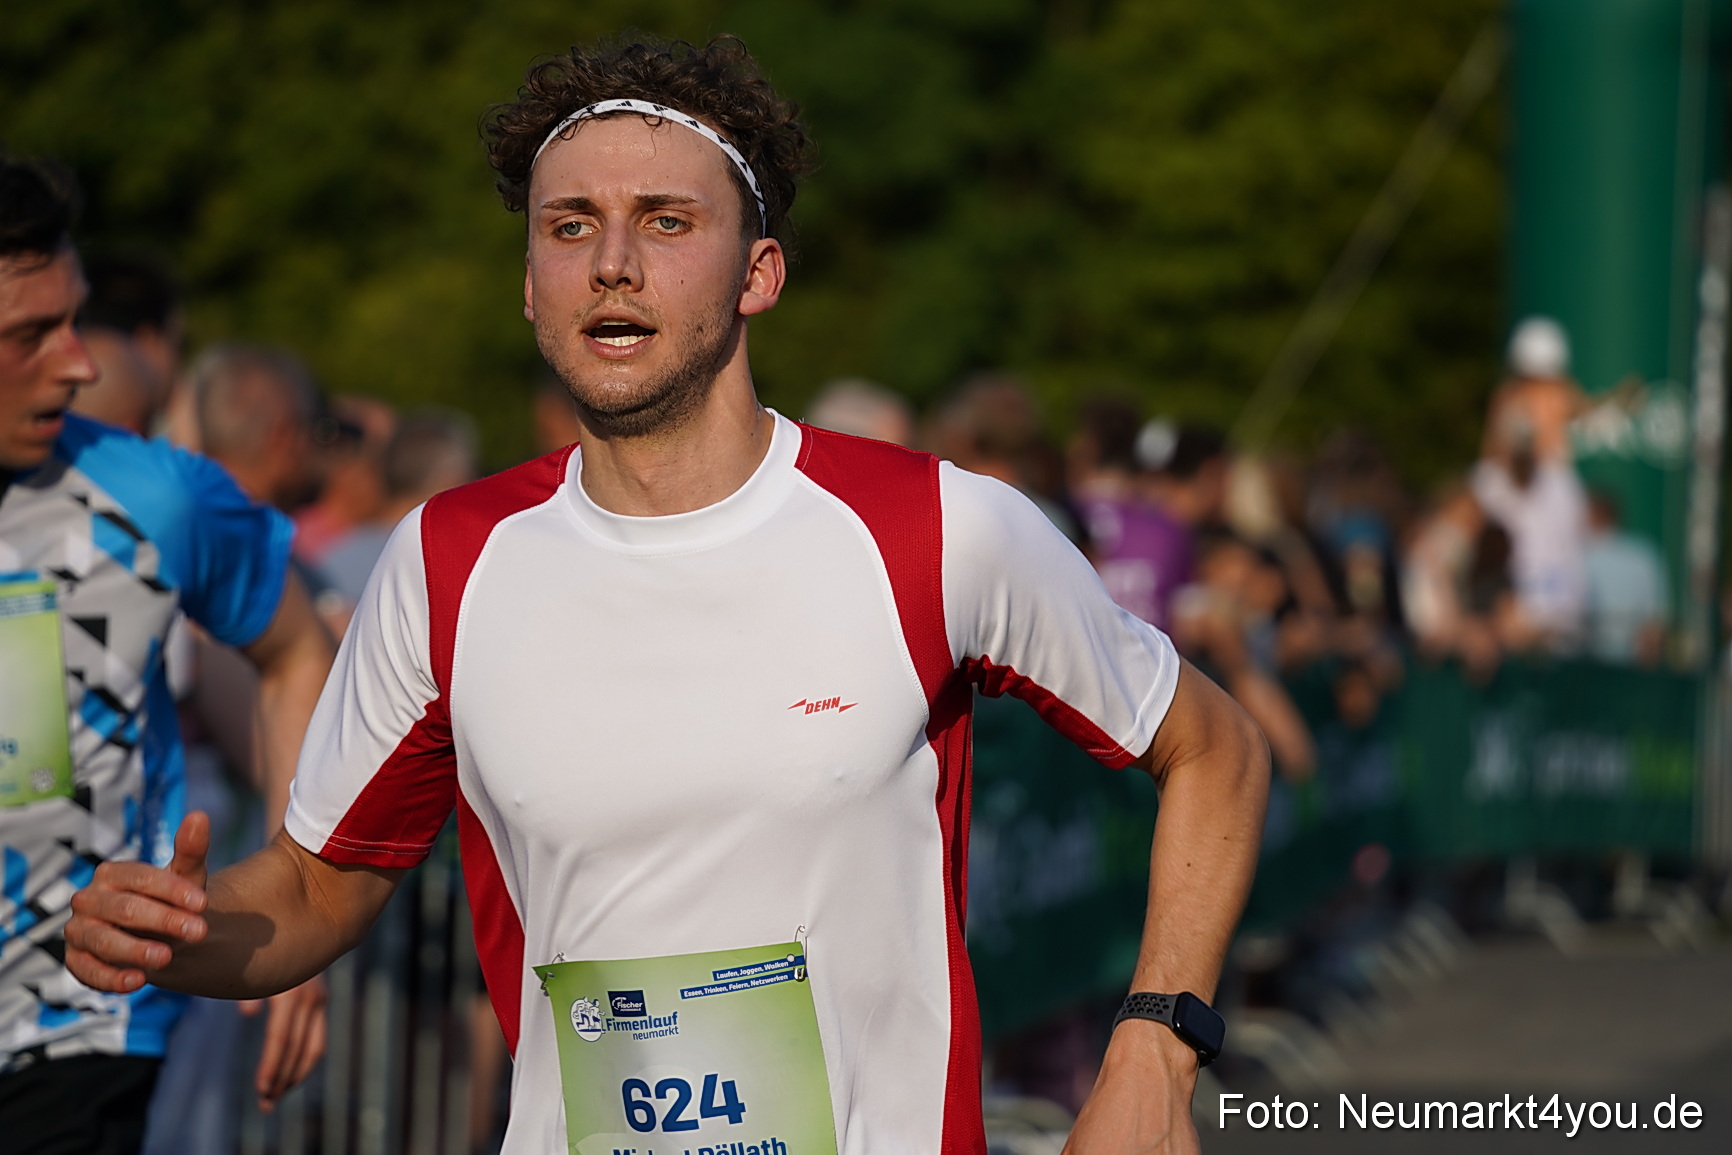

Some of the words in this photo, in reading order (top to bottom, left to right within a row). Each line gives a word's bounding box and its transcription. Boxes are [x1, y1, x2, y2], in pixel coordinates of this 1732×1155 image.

[804, 696, 841, 715] DEHN
[716, 970, 740, 980] Laufen,
[739, 965, 765, 977] Joggen,
[763, 961, 789, 972] Walken
[683, 989, 704, 998] Essen,
[703, 984, 729, 995] Trinken,
[728, 980, 751, 991] Feiern,
[750, 974, 789, 987] Netzwerken
[614, 999, 643, 1009] Fischer
[605, 1011, 678, 1032] Firmenlauf
[632, 1026, 679, 1041] neumarkt
[621, 1073, 747, 1133] 624
